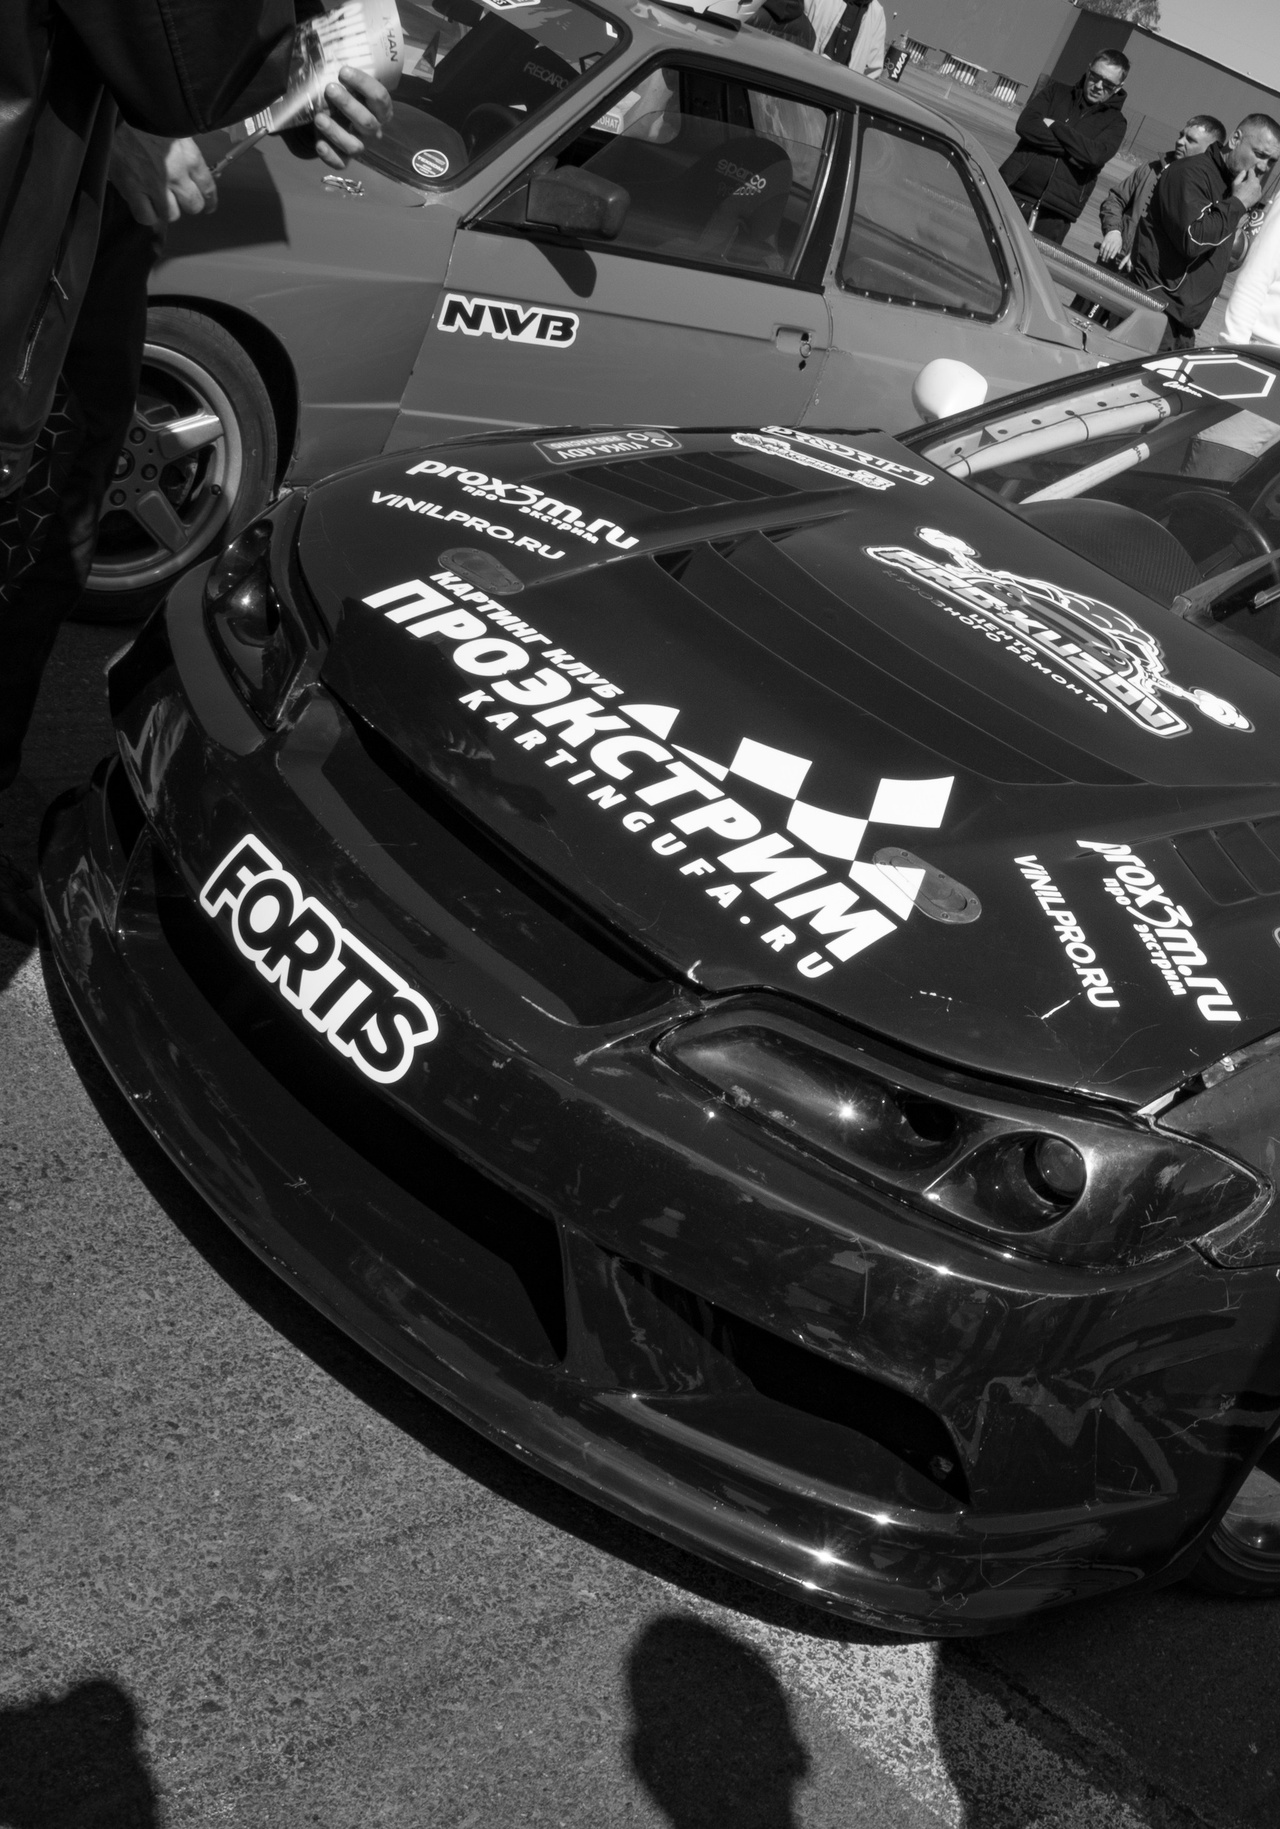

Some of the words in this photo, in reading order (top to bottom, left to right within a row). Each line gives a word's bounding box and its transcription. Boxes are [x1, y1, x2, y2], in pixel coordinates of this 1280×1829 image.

[717, 158, 767, 190] sparco
[441, 298, 577, 343] NWB
[549, 438, 597, 449] RACING
[556, 446, 597, 460] ADV
[594, 441, 649, 454] YUKA
[371, 490, 566, 560] VINILPRO.RU
[405, 459, 640, 550] prox3m.ru
[428, 570, 554, 648] КАРТИНГ
[541, 646, 625, 700] КЛУБ
[882, 569, 1002, 644] КУЗОВНОГО
[1005, 644, 1110, 714] РЕМОНТА
[968, 612, 1038, 657] ЦЕНТР
[361, 578, 898, 962] ПРОЭКСТРИМ
[458, 688, 834, 979] KARTINGUFA.RU
[202, 846, 433, 1074] FORTIS
[1013, 853, 1120, 1009] VINILPRO.RU
[1075, 839, 1242, 1022] prox3m.ru
